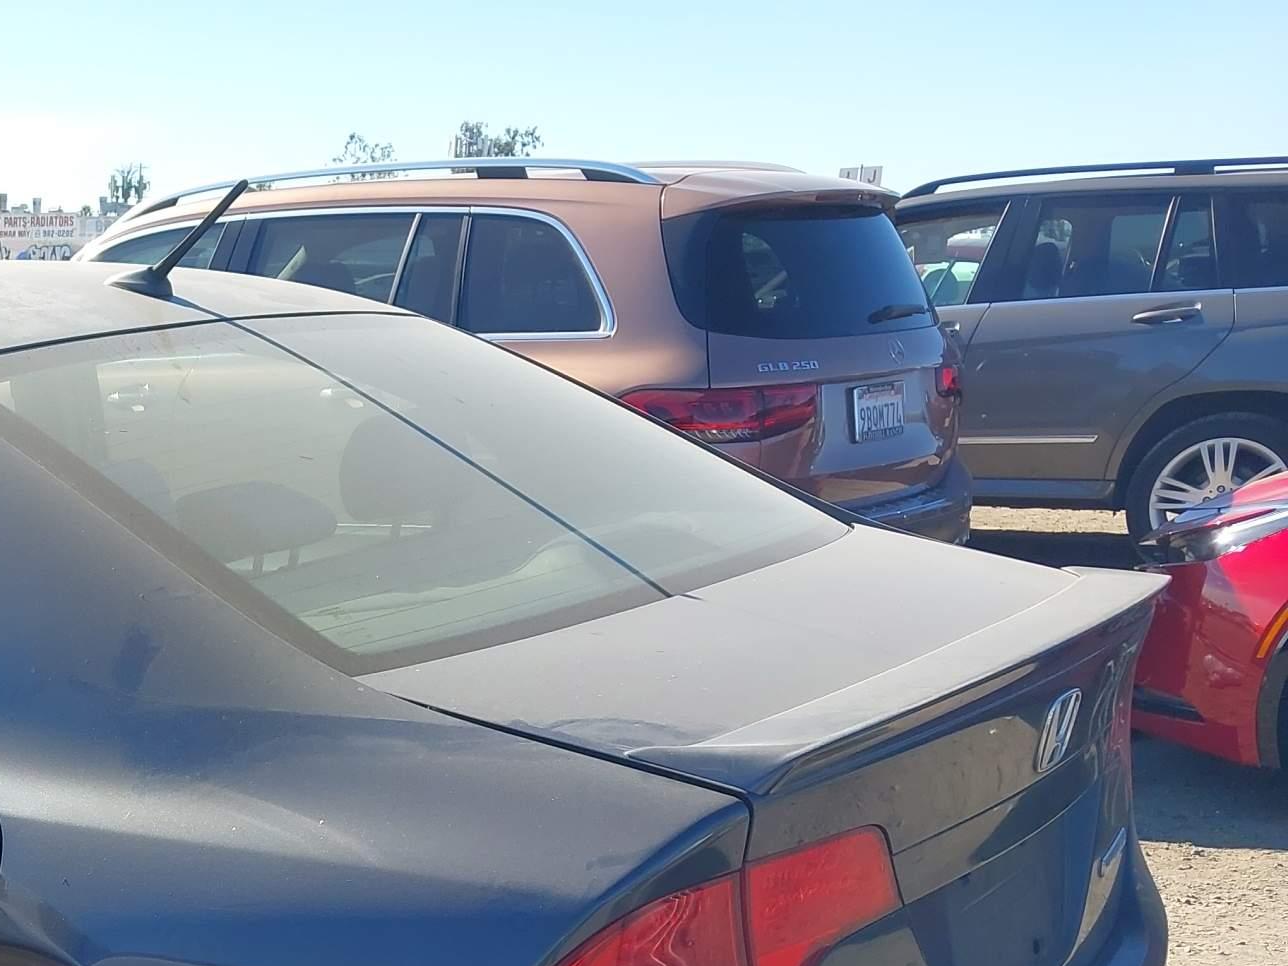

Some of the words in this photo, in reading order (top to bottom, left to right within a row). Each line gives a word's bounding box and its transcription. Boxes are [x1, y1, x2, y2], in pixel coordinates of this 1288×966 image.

[867, 168, 877, 184] J
[758, 361, 789, 372] GLB
[791, 360, 820, 371] 250
